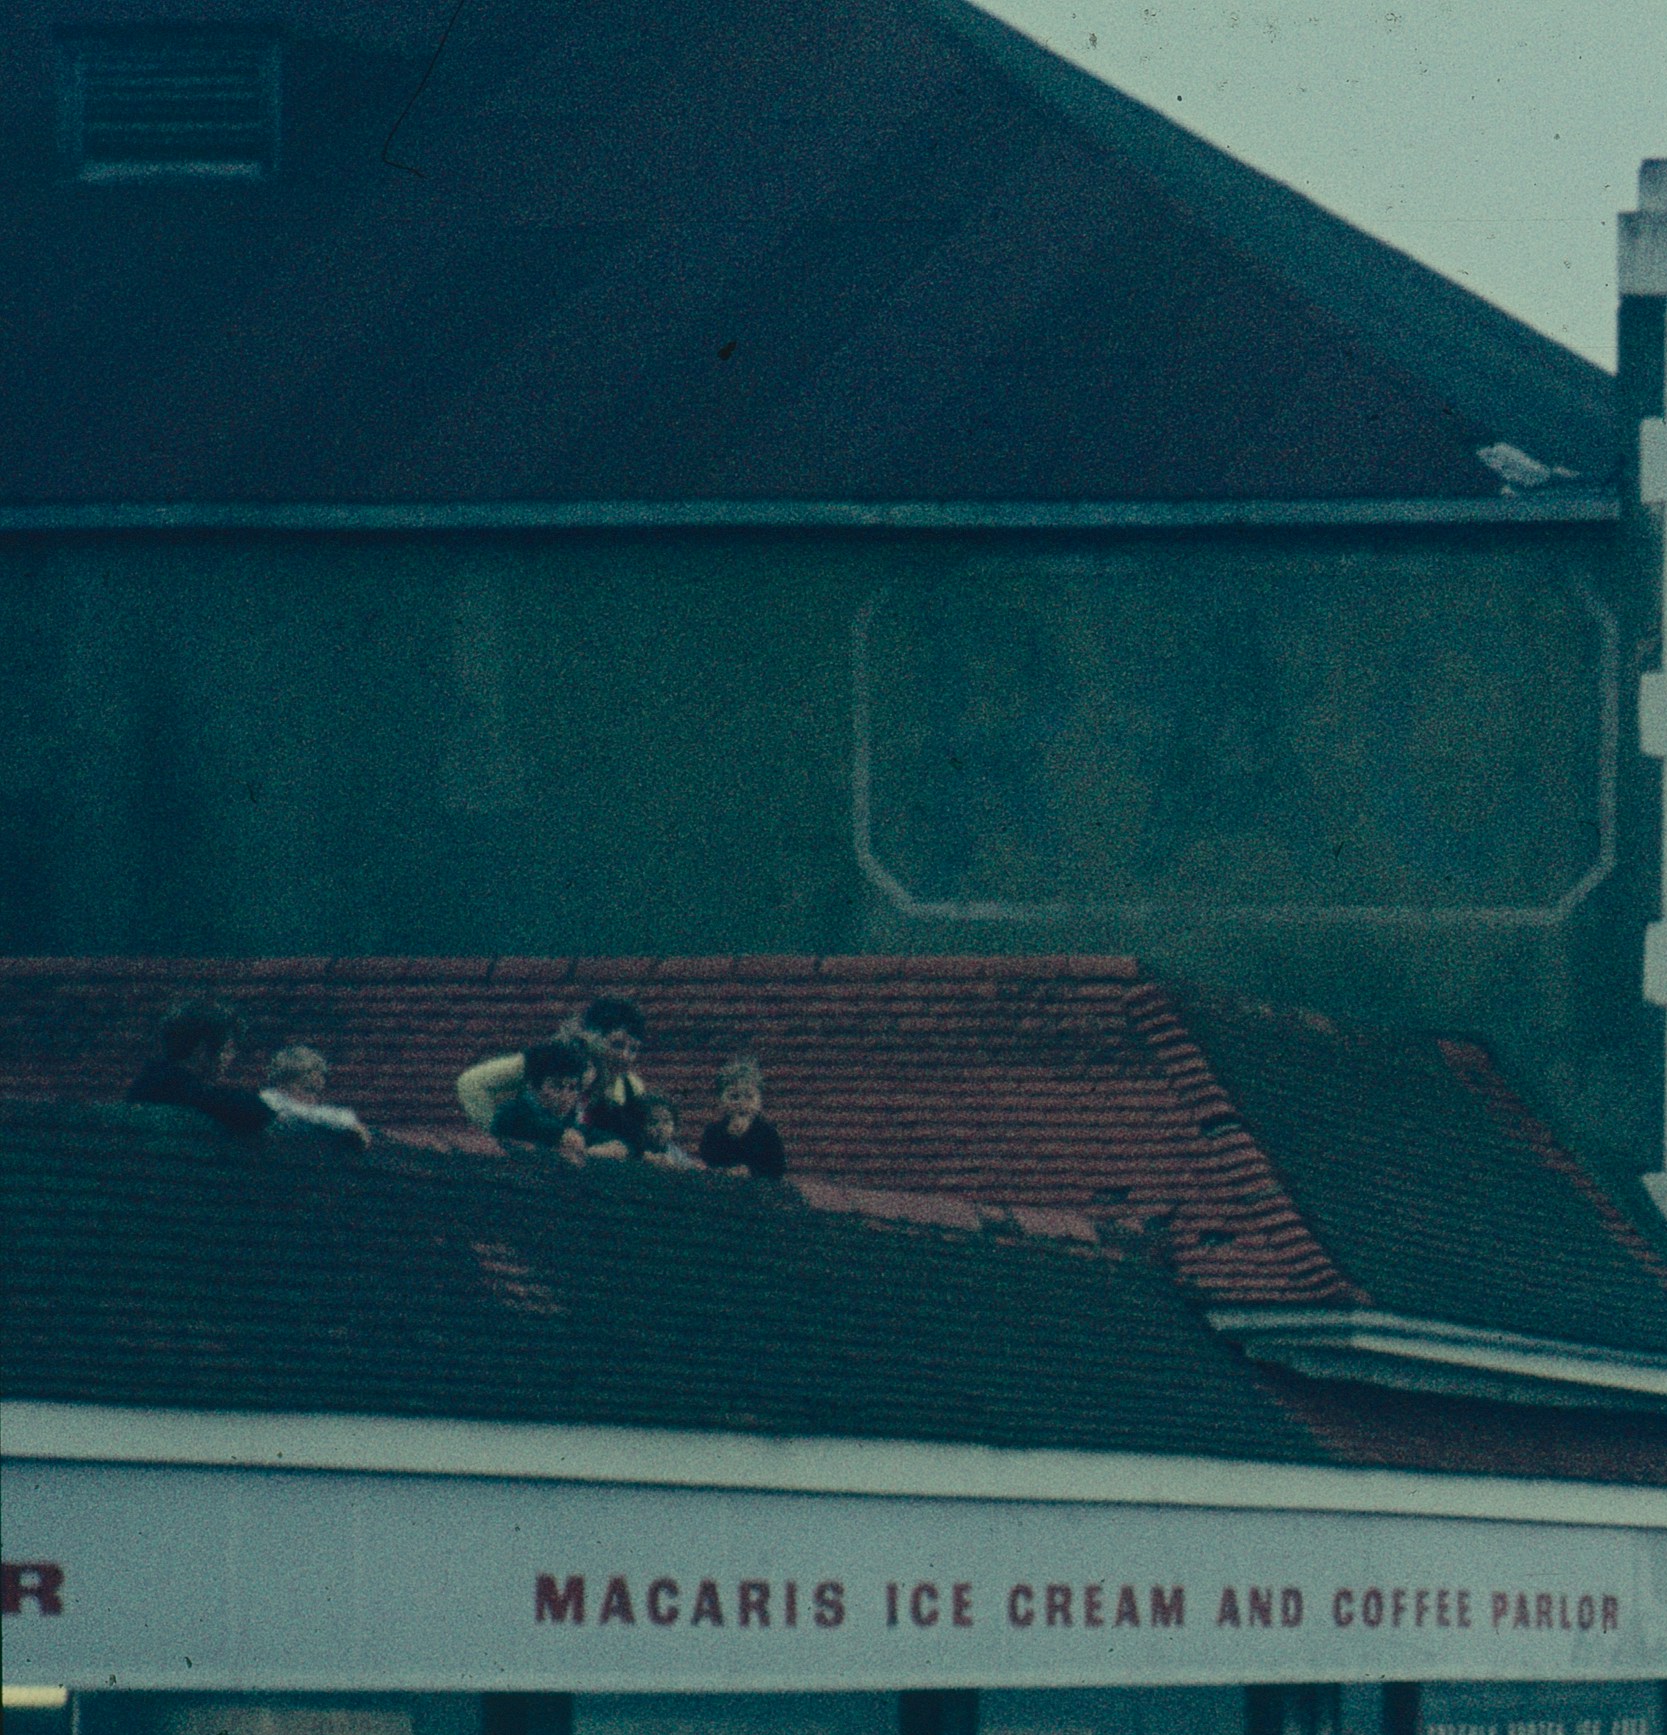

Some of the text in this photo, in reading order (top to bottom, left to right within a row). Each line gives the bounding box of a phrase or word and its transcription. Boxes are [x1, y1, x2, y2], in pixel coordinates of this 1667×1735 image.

[534, 1572, 1620, 1633] MACARIS ICE CREAM AND COFFEE PARLOR
